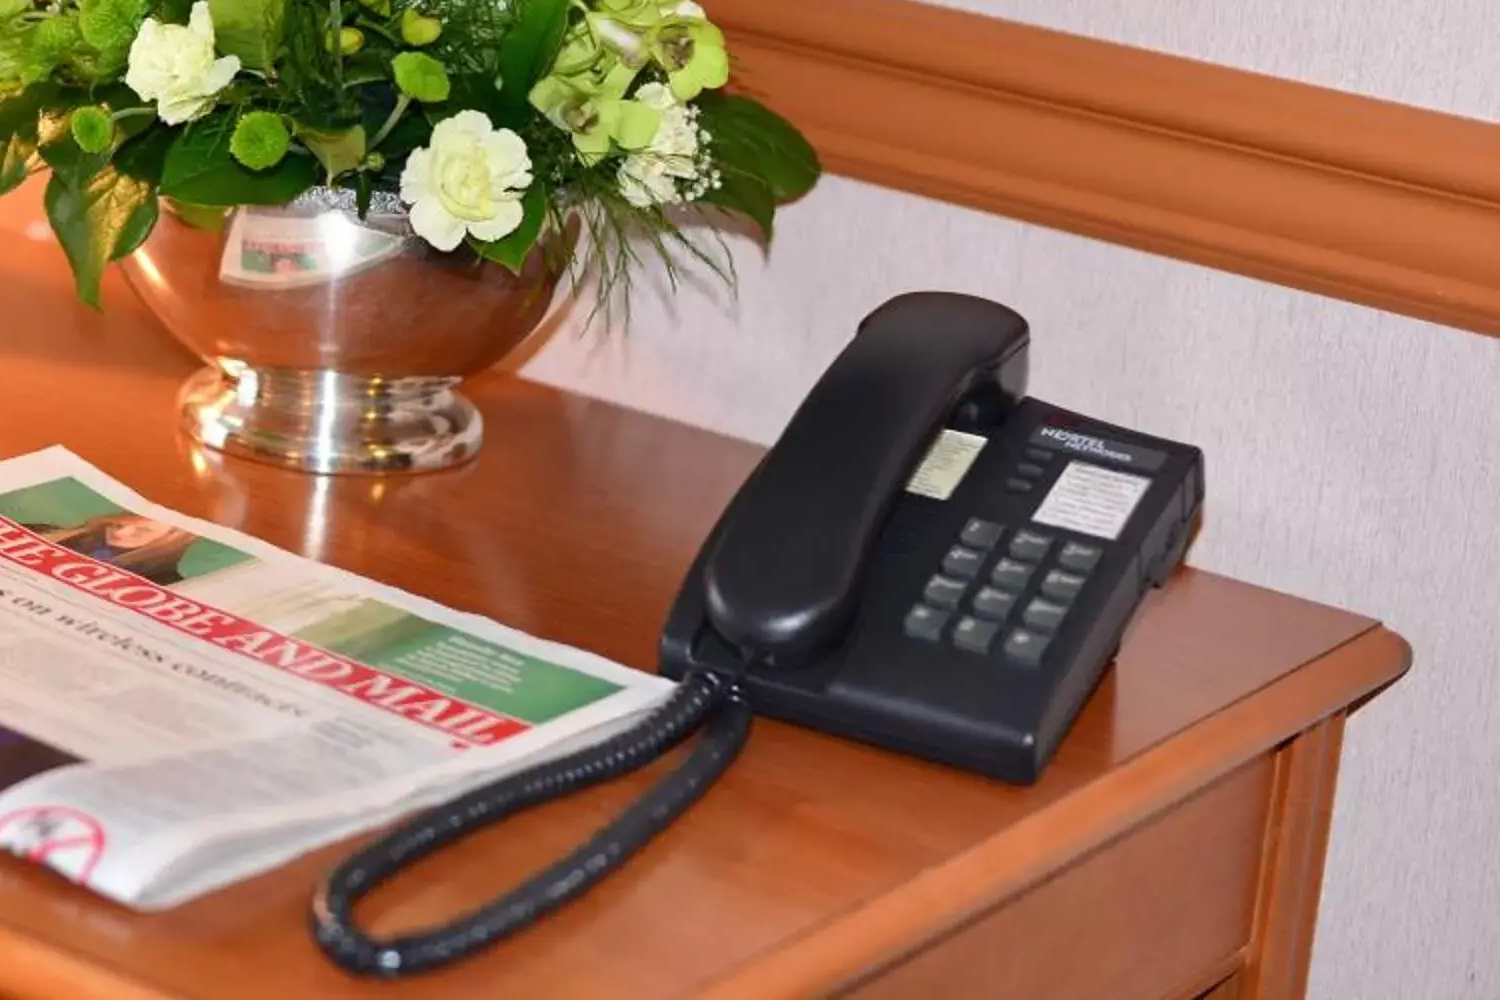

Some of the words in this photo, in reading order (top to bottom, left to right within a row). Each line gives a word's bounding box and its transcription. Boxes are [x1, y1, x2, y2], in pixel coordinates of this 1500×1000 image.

[11, 596, 53, 616] on
[52, 560, 236, 636] GLOBE
[212, 630, 354, 681] AND
[344, 673, 506, 743] MAIL
